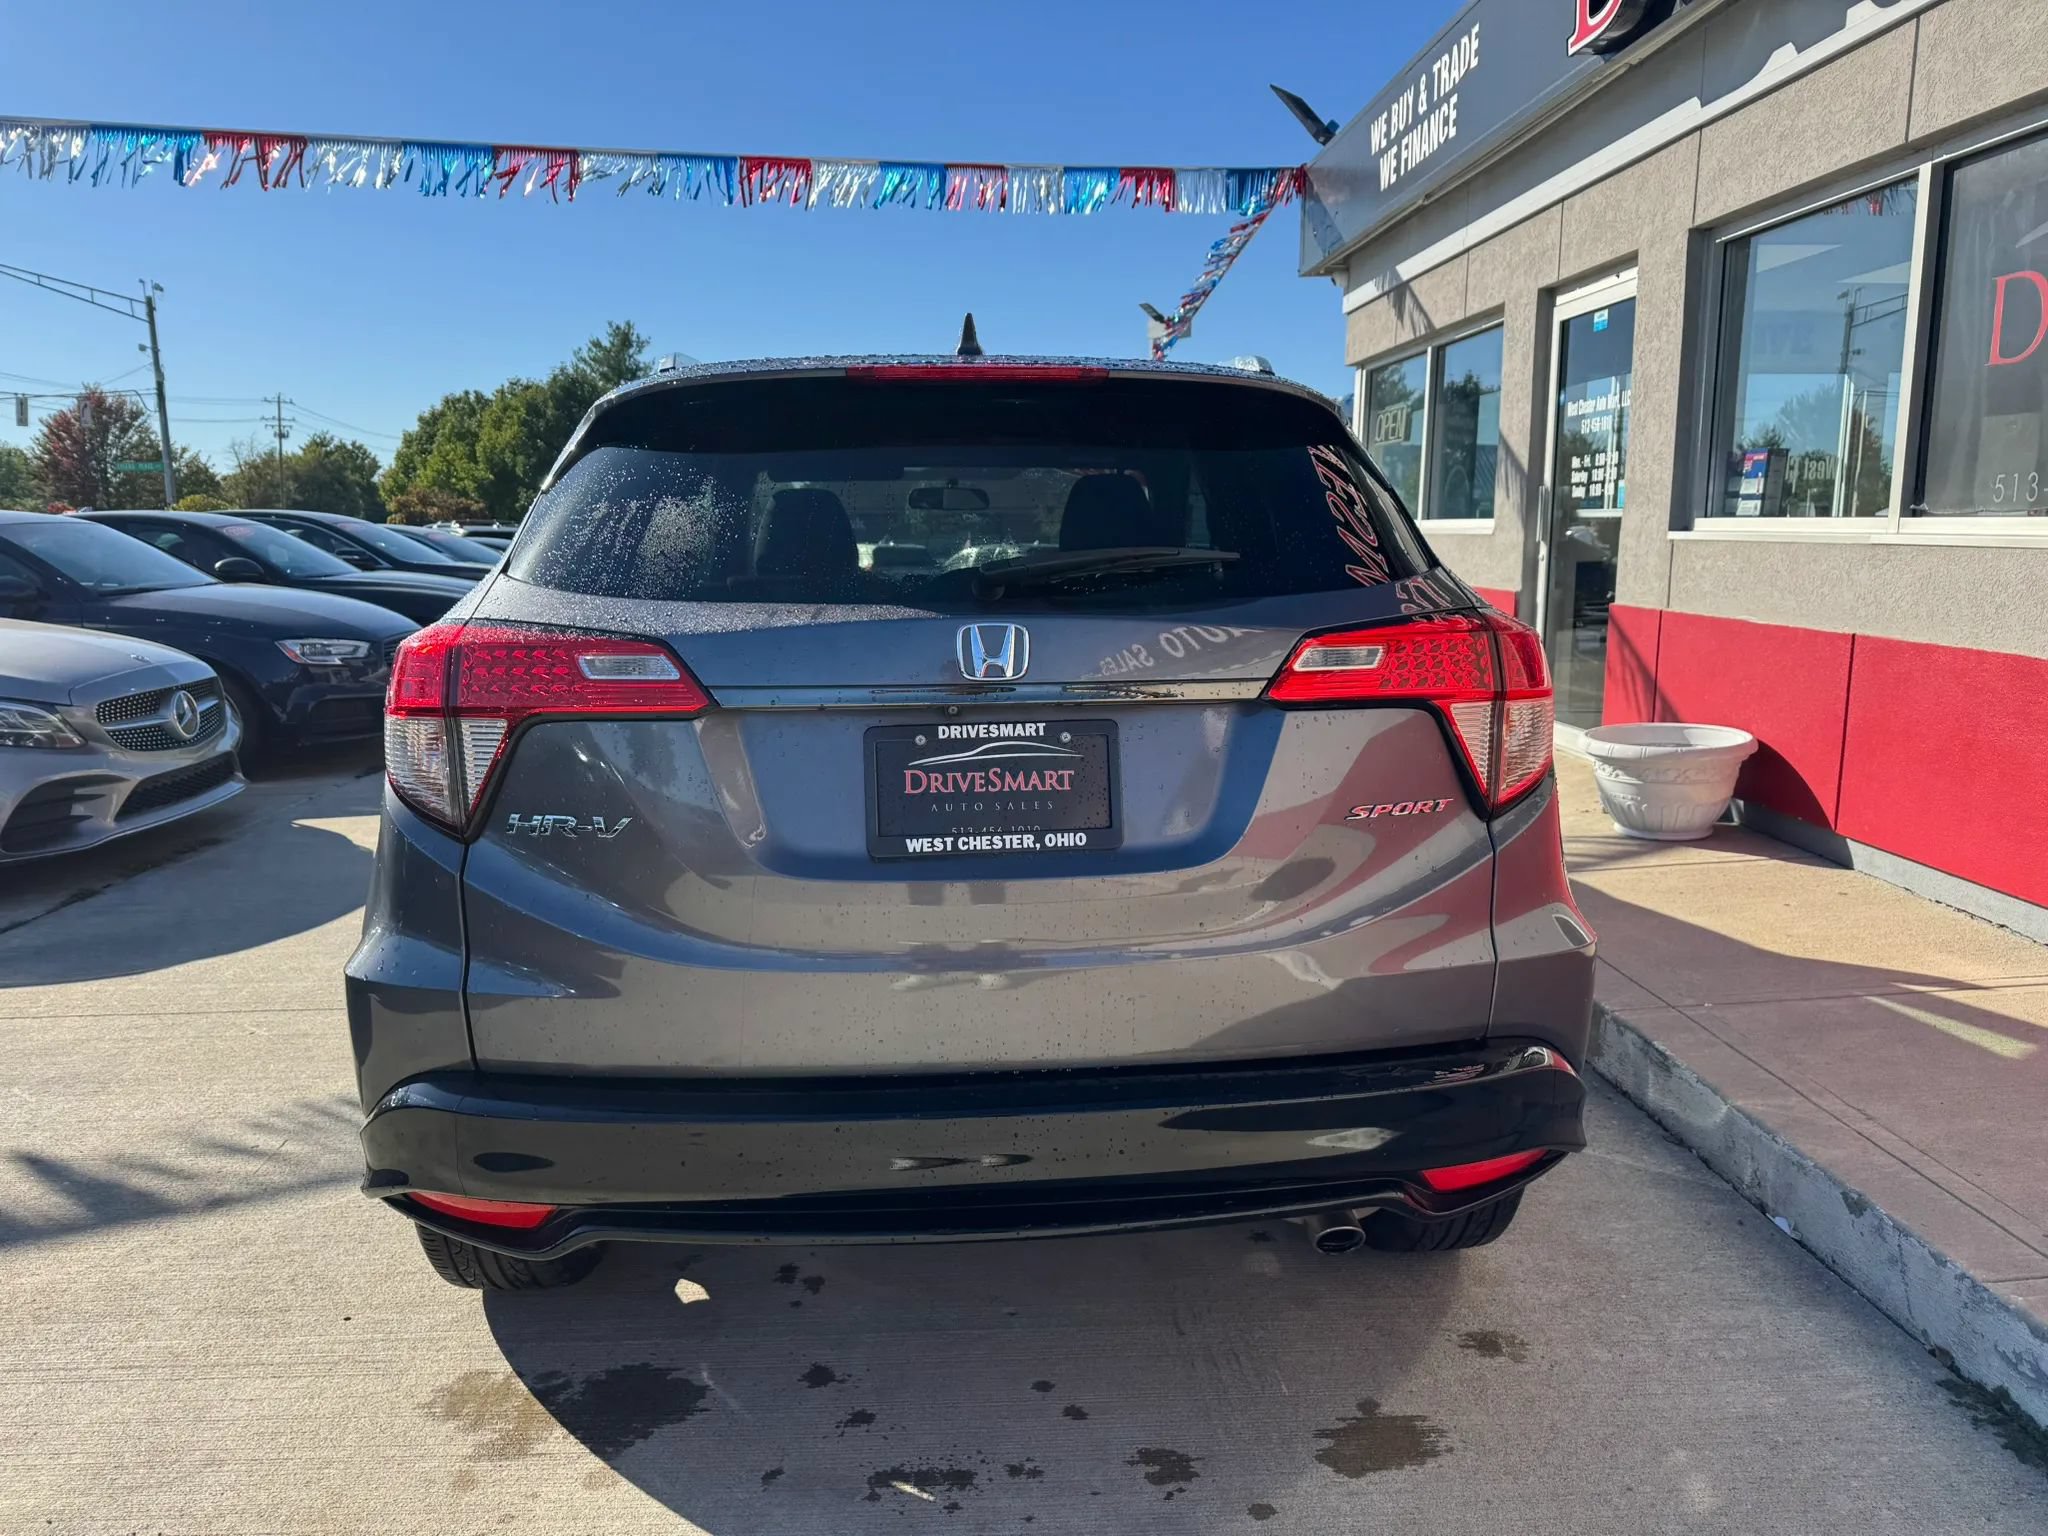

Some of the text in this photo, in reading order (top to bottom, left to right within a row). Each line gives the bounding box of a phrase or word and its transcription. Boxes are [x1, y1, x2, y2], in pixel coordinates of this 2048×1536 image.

[1371, 21, 1480, 156] WE BUY & TRADE
[1379, 93, 1458, 192] WE FINANCE
[1375, 406, 1406, 441] OPEN
[938, 723, 1046, 739] DRIVESMART
[932, 801, 1053, 812] AUTO SALES
[1344, 799, 1454, 820] SPORT
[506, 813, 632, 838] HR-V
[906, 832, 1087, 853] WEST CHESTER, OHIO
